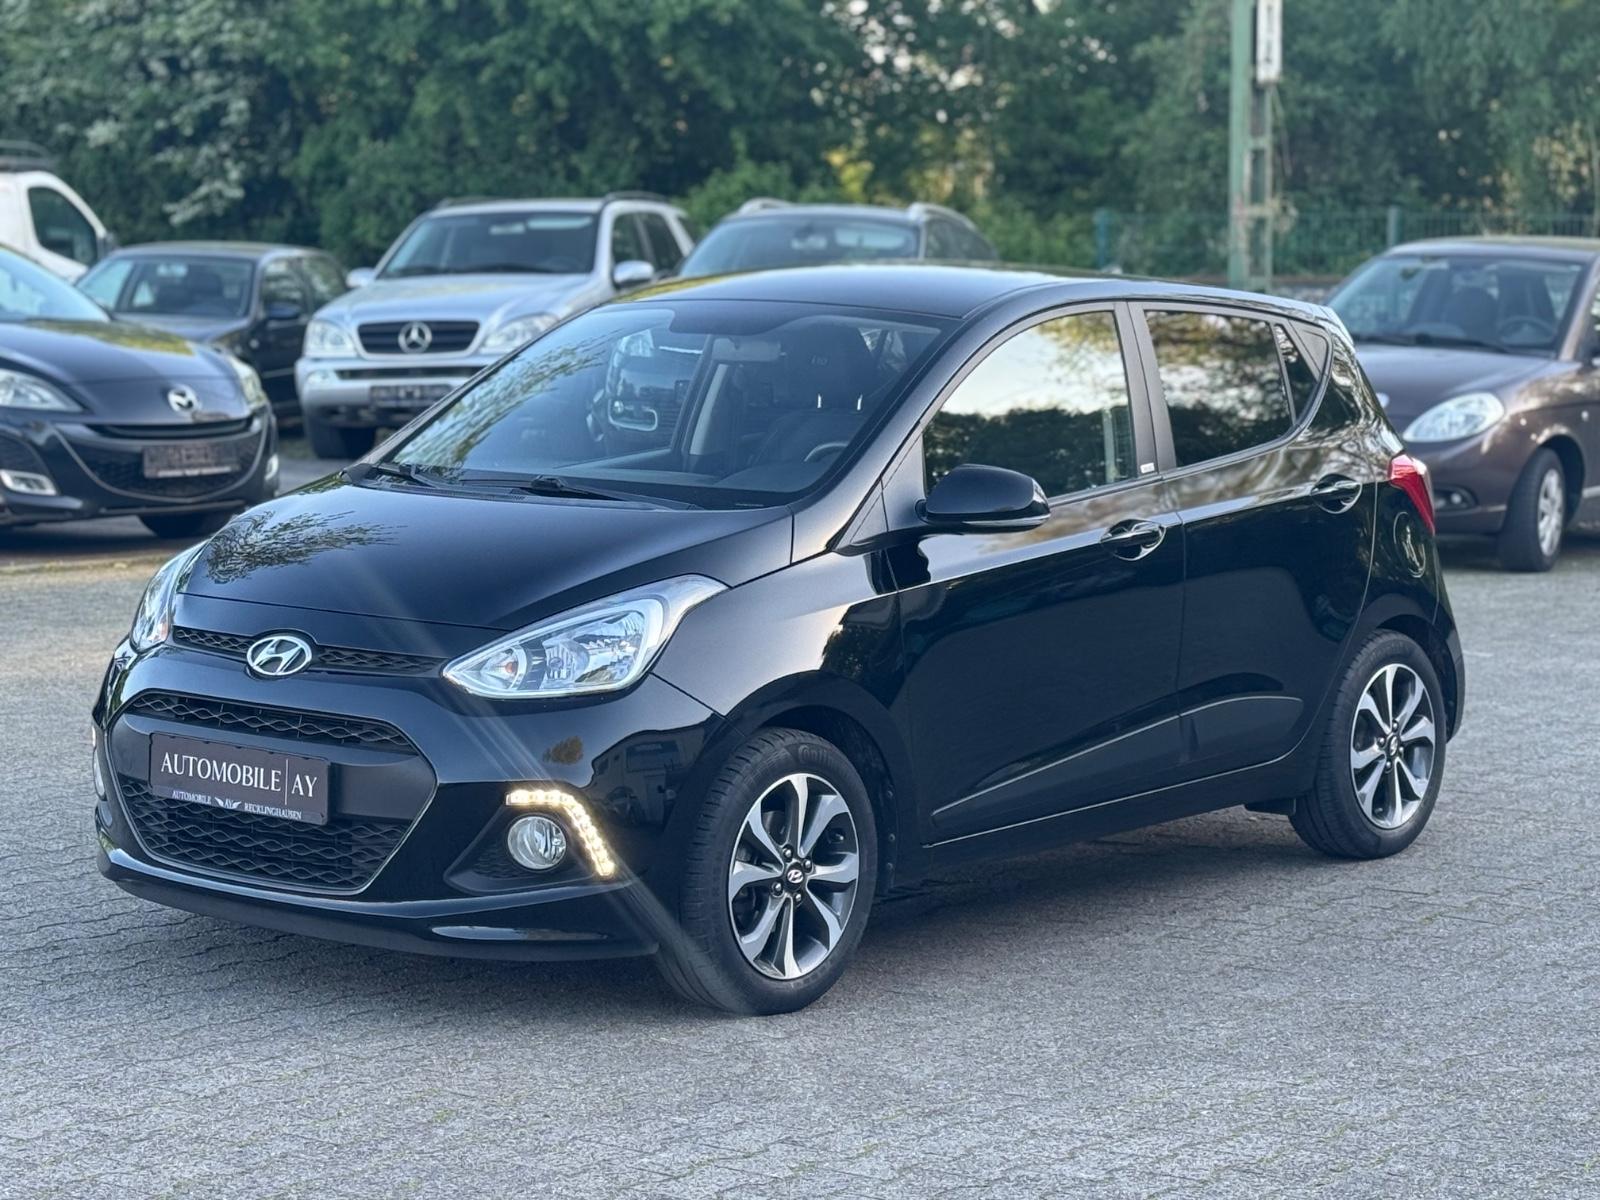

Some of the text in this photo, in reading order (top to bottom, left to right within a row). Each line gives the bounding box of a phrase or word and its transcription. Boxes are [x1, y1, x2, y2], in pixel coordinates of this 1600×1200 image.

[161, 752, 317, 798] AUTOMOBILE AY
[172, 790, 212, 805] AUTOMOBILE
[244, 803, 302, 820] RECKLINGHAUSEN
